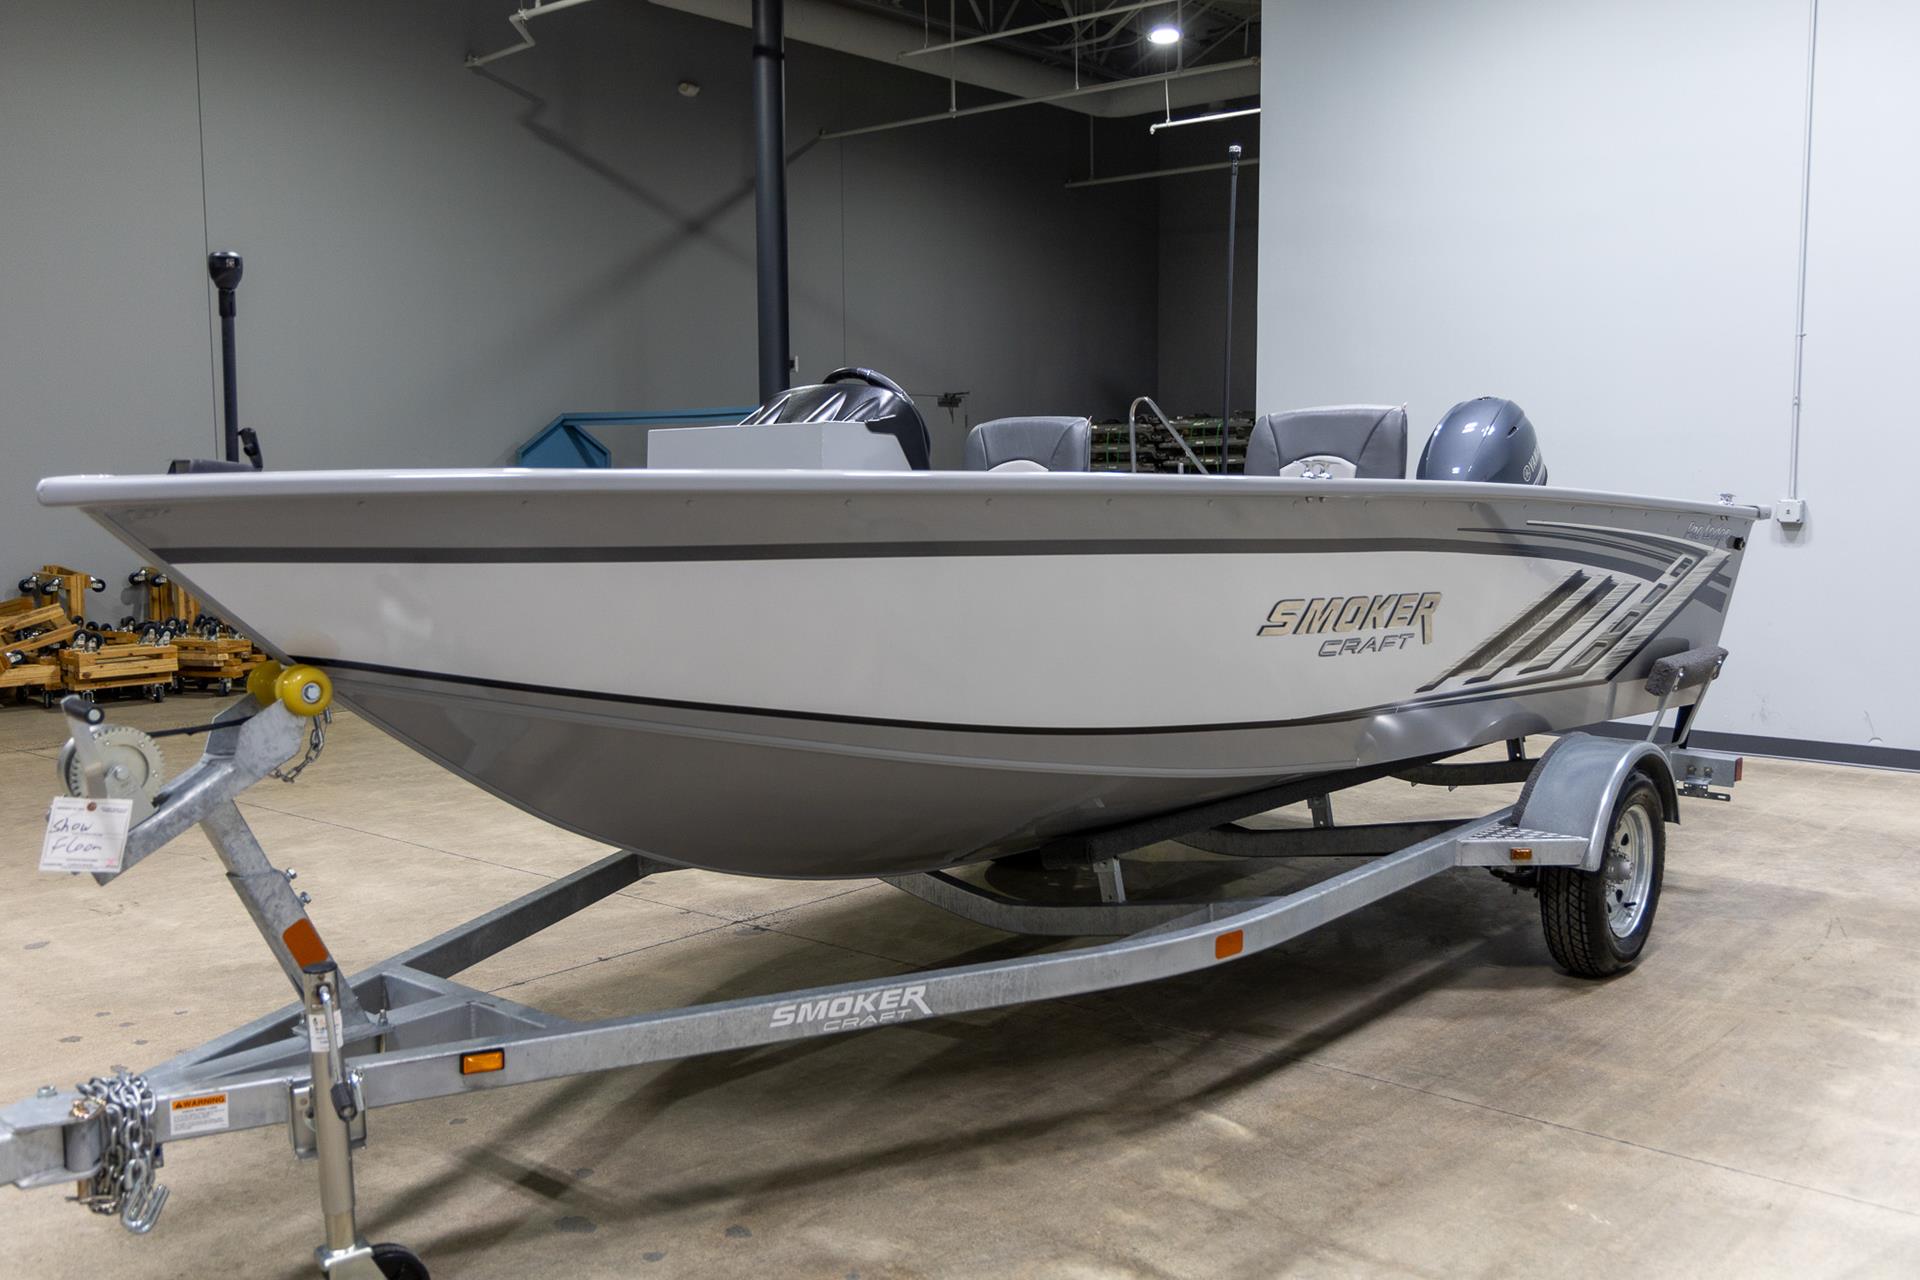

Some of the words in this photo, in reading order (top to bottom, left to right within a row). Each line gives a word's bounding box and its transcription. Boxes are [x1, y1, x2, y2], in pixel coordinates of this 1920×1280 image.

[1256, 592, 1441, 645] SMOKER
[1318, 633, 1415, 657] CRAFT
[770, 985, 933, 1028] SMOKER
[823, 1009, 912, 1032] CRAFT
[184, 1095, 225, 1108] WARNING
